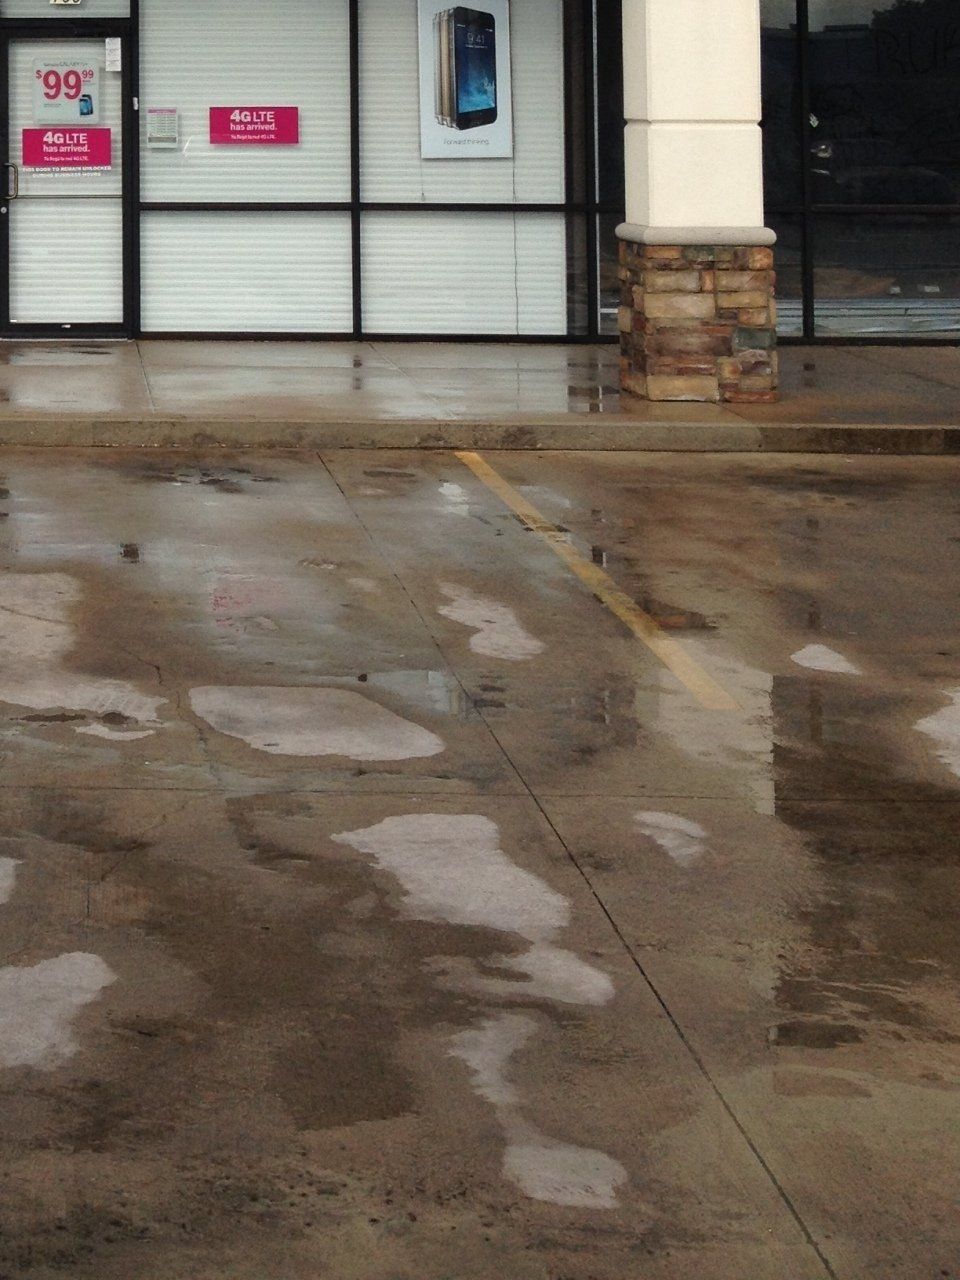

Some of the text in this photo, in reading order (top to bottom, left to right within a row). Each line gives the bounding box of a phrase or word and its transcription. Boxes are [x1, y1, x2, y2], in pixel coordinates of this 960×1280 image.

[230, 109, 275, 122] 4G LTE
[230, 122, 278, 131] has arrived.
[42, 131, 88, 144] 4G LTE
[42, 144, 91, 153] has arrived.
